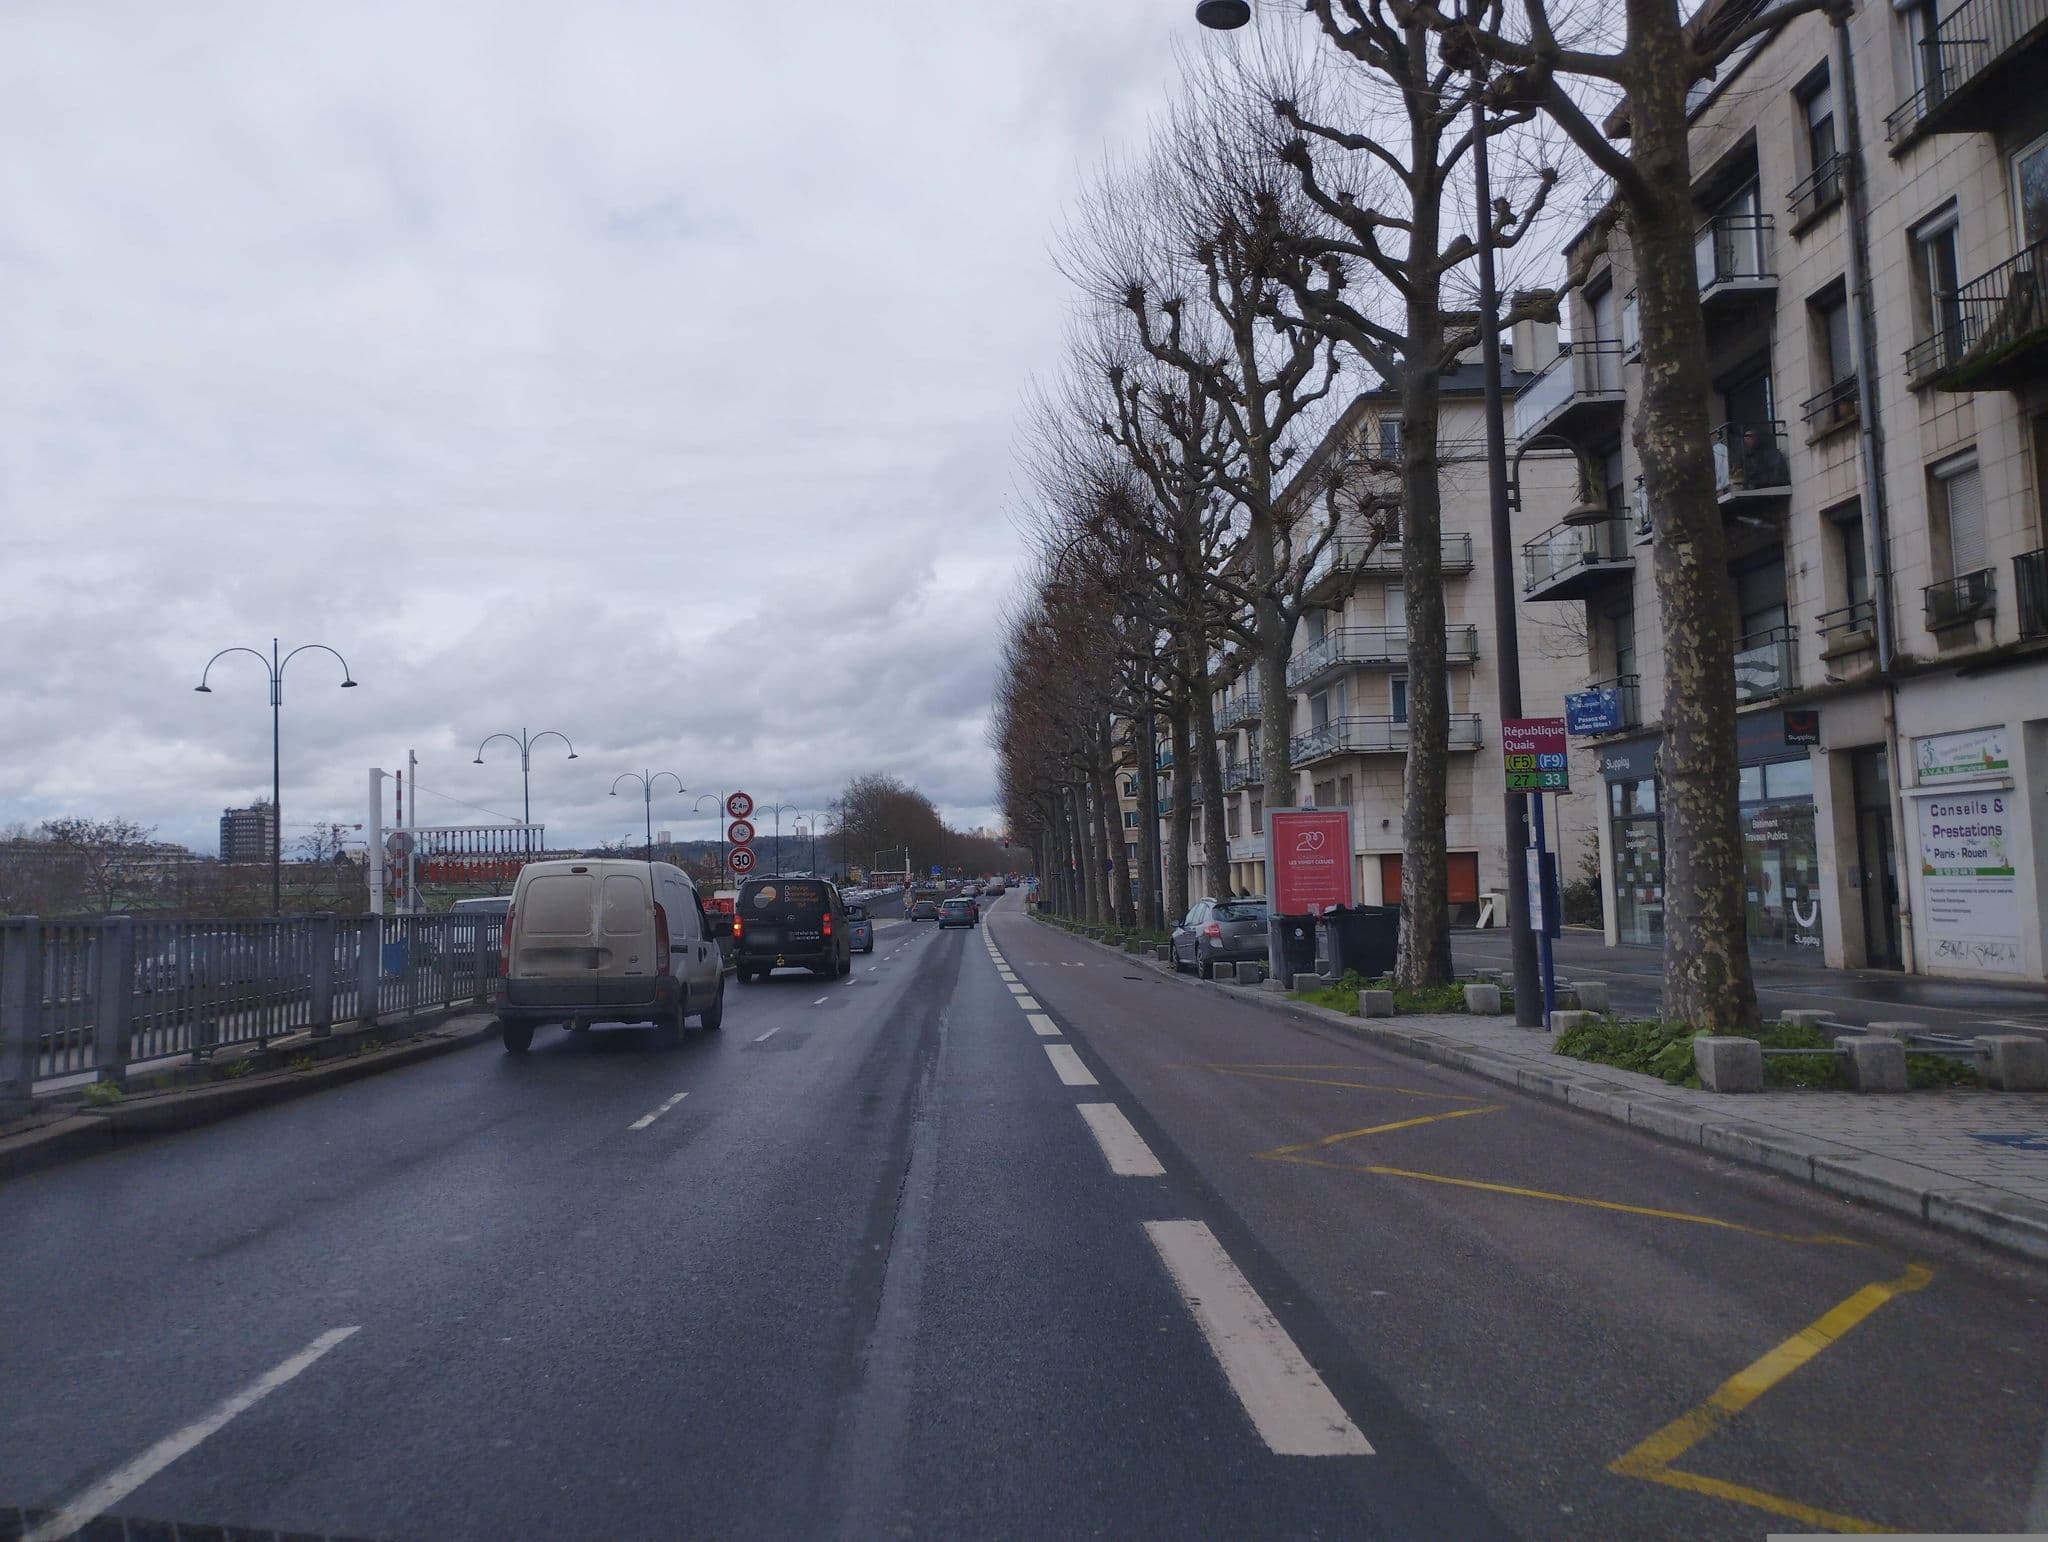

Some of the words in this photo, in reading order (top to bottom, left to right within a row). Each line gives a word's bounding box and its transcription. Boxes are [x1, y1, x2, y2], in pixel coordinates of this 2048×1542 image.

[1504, 725, 1564, 738] République
[1787, 733, 1816, 744] Supplay
[1504, 740, 1535, 751] Quais
[1508, 754, 1532, 769] (F5)
[1539, 753, 1564, 768] (F9)
[1605, 757, 1630, 771] Supplay
[1514, 775, 1530, 786] 27
[1545, 773, 1561, 785] 33
[1930, 801, 1988, 817] Conseils
[1993, 798, 2004, 813] &
[1766, 831, 1789, 841] Publics
[1932, 823, 2003, 839] Prestations
[1934, 848, 1956, 859] Paris
[1961, 847, 1988, 858] Rouen
[734, 854, 750, 867] 30
[1794, 934, 1821, 948] Supplay
